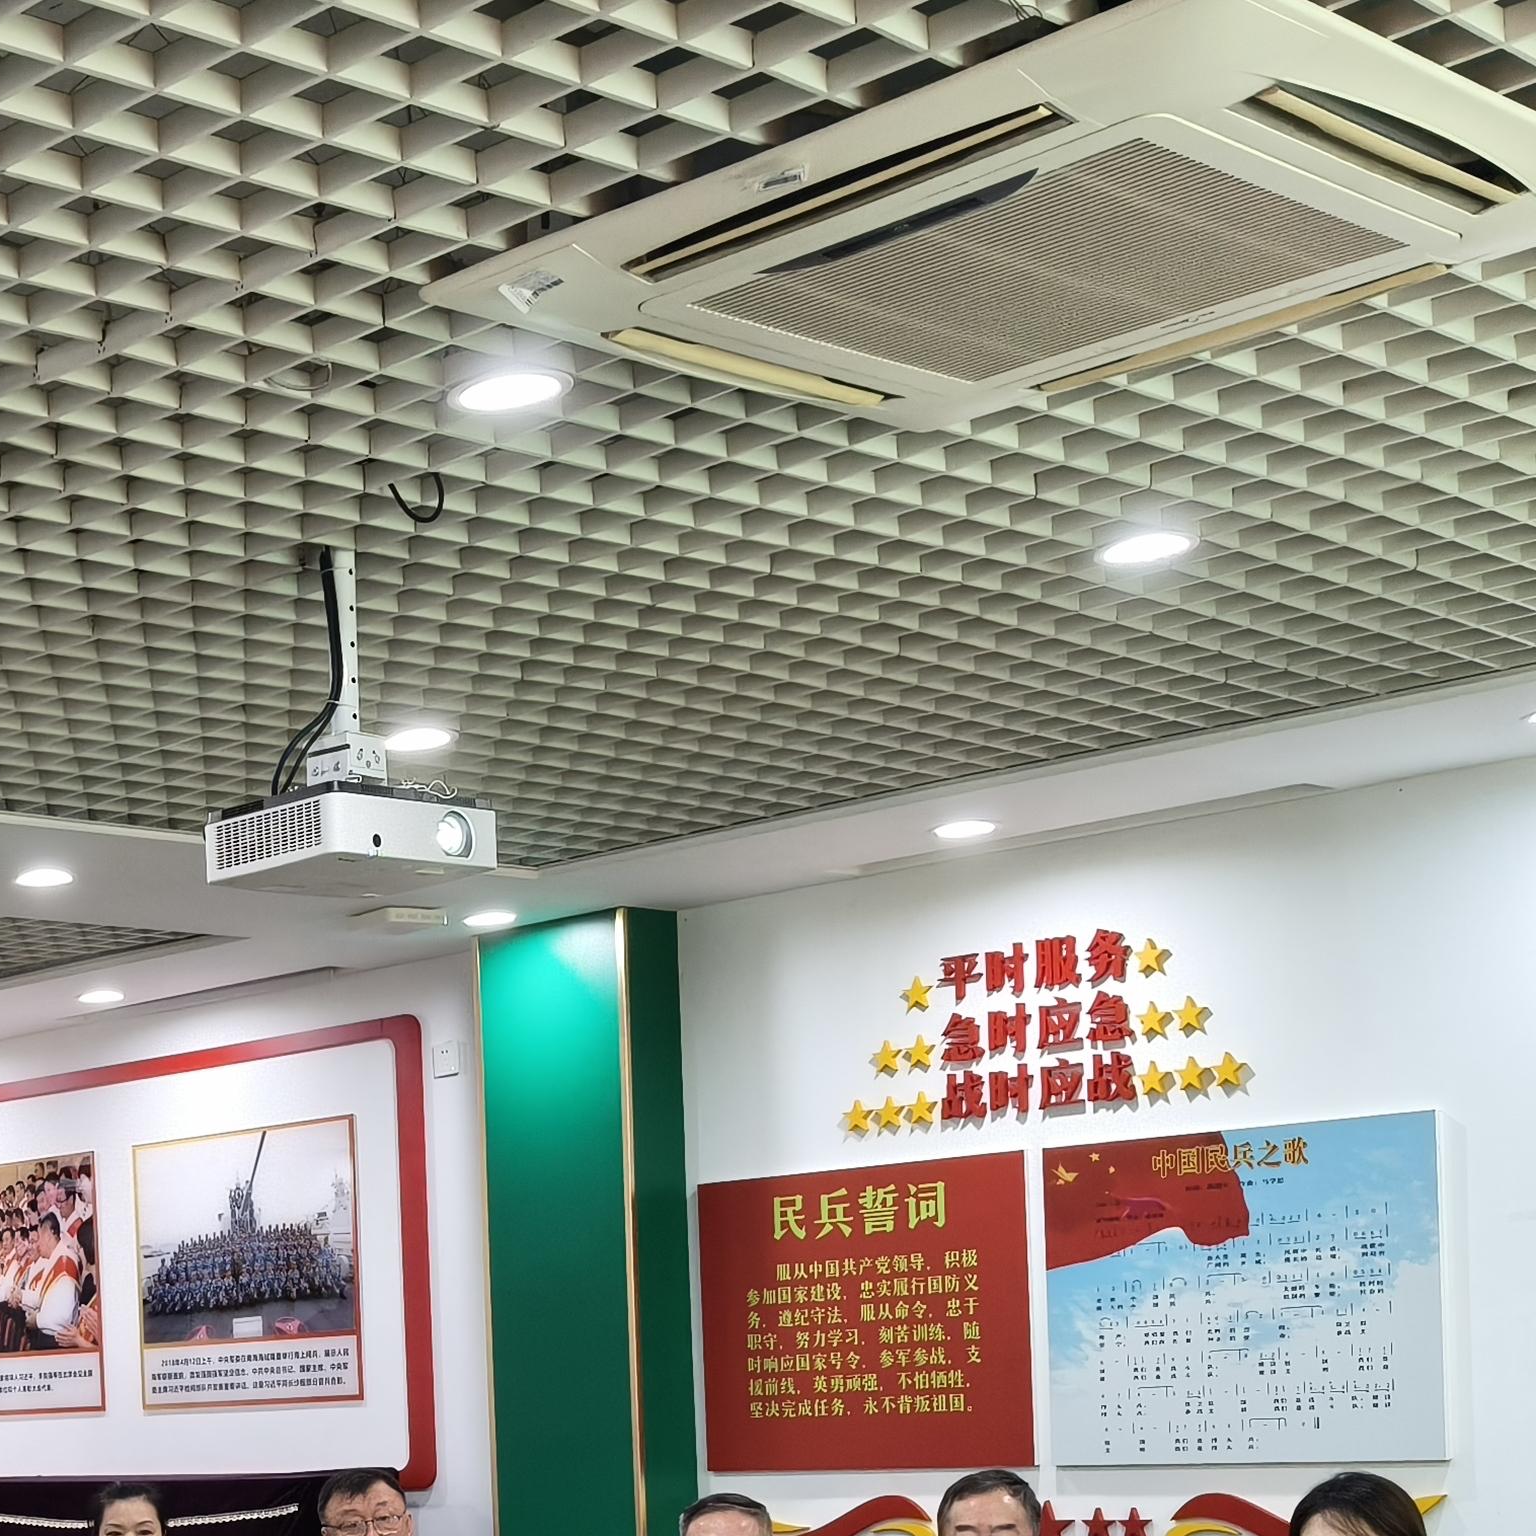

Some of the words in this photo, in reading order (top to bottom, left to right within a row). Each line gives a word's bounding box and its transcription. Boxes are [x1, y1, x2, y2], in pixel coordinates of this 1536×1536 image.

[939, 928, 1131, 1003] 平时服务
[941, 990, 1134, 1065] 急时应急
[940, 1051, 1136, 1122] 战时应战
[1152, 1136, 1309, 1179] 中国民兵之歌
[772, 1180, 946, 1241] 民兵誓词
